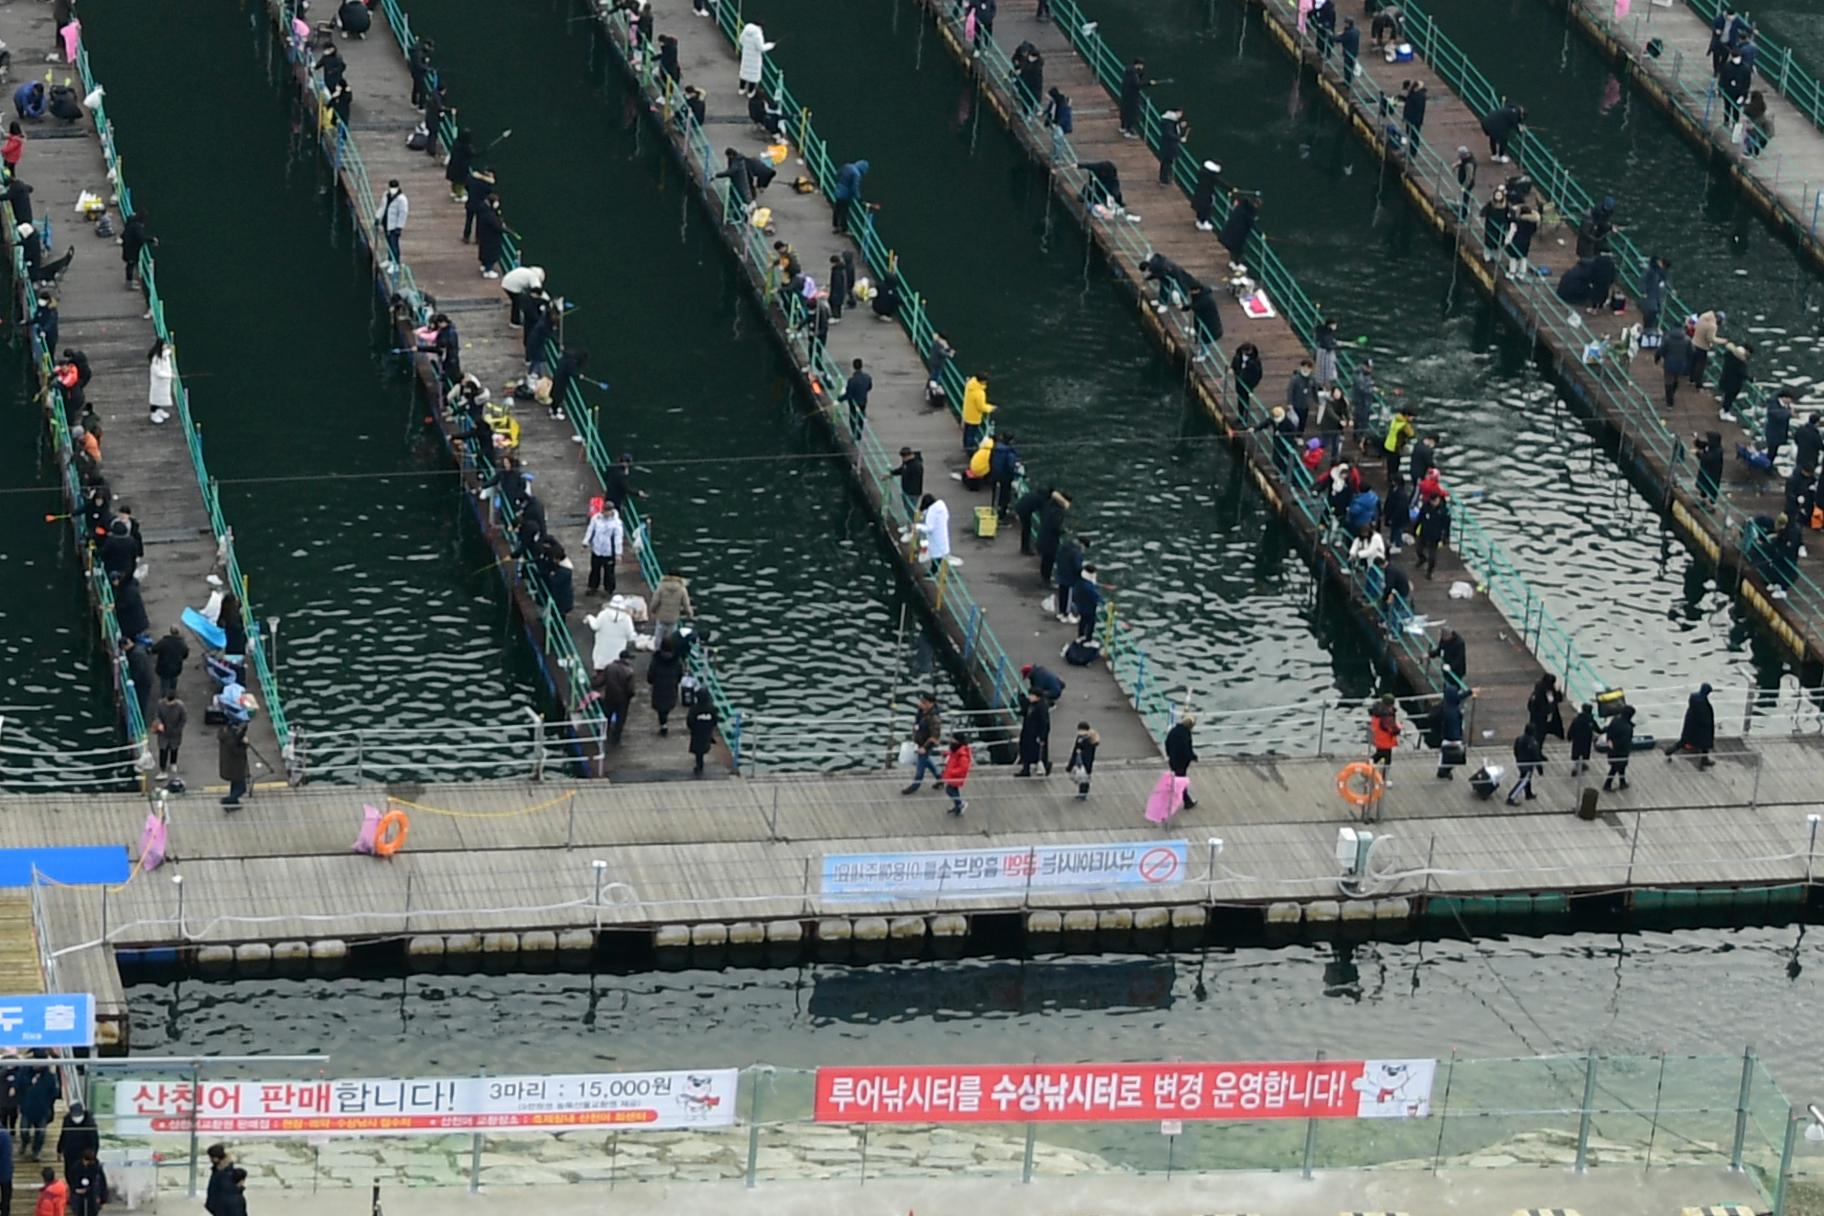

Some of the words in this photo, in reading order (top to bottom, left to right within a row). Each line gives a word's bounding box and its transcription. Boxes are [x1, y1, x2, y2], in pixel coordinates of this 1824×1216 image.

[132, 1084, 241, 1114] 산천어
[260, 1081, 455, 1113] 판매합니다!
[489, 1080, 546, 1101] 3마리
[578, 1077, 672, 1099] 15,000원
[829, 1075, 982, 1113] 루어낚시터를
[991, 1073, 1143, 1112] 수상낚시터로
[1154, 1072, 1204, 1110] 변경
[1212, 1070, 1346, 1111] 운영합니다!
